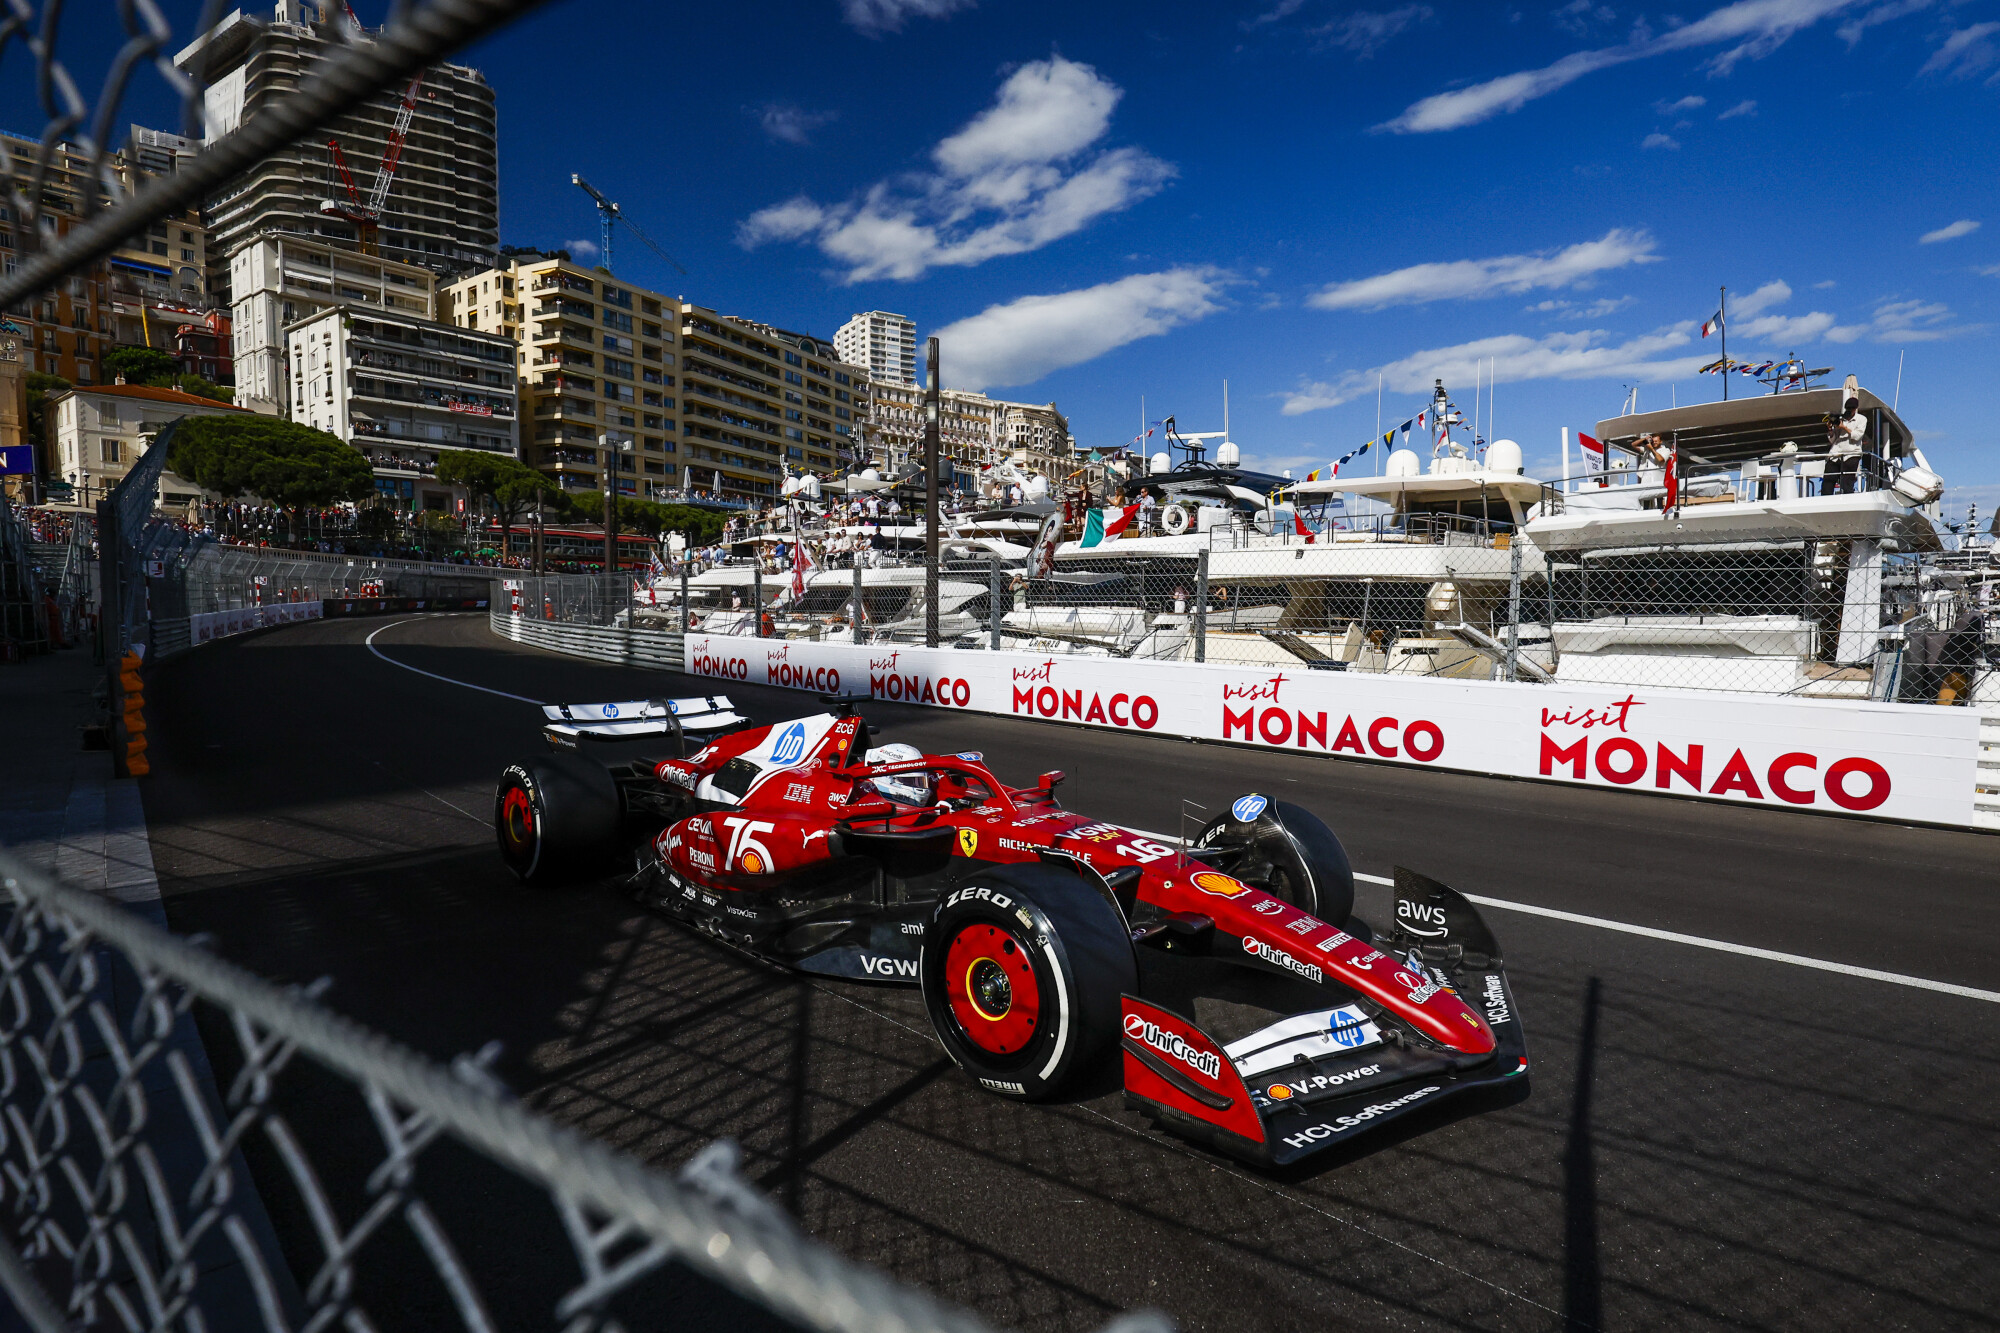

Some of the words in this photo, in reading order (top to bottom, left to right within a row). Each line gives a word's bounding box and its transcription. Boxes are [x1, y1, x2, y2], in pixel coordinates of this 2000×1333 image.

[693, 638, 710, 653] visit
[767, 643, 790, 661] visit
[693, 654, 748, 681] MONACO
[869, 650, 900, 670] visit
[1012, 658, 1057, 683] visit
[767, 662, 840, 693] MONACO
[870, 672, 970, 707] MONACO
[1223, 673, 1290, 704] visit
[604, 704, 618, 718] hp
[1012, 683, 1159, 730] MONACO
[1541, 693, 1646, 733] visit
[835, 722, 855, 735] ZCG
[1222, 703, 1445, 763] MONACO
[770, 723, 804, 765] hp
[509, 764, 533, 788] ZERO
[888, 761, 927, 770] TECHNOLOGY
[1539, 731, 1892, 811] MONACO
[783, 783, 815, 804] IBM
[828, 791, 848, 804] aws
[1234, 796, 1265, 821] hp
[1054, 822, 1120, 841] VGW
[1087, 831, 1122, 843] PLAY
[689, 846, 715, 868] PERONI
[723, 816, 776, 875] 75
[1116, 838, 1176, 864] 16
[702, 894, 718, 907] SKF
[946, 886, 1013, 909] ZERO
[1251, 899, 1278, 912] aws
[1397, 899, 1446, 925] aws
[859, 954, 918, 977] VGW
[1259, 942, 1322, 984] UniCredit
[1407, 981, 1442, 1005] UniCredit
[1483, 974, 1511, 1026] HCLSoftware
[1143, 1021, 1221, 1081] UniCredit
[978, 1076, 1027, 1096] PIRELLI
[1289, 1063, 1382, 1095] V-Power
[1281, 1085, 1441, 1149] HCLSoftware
